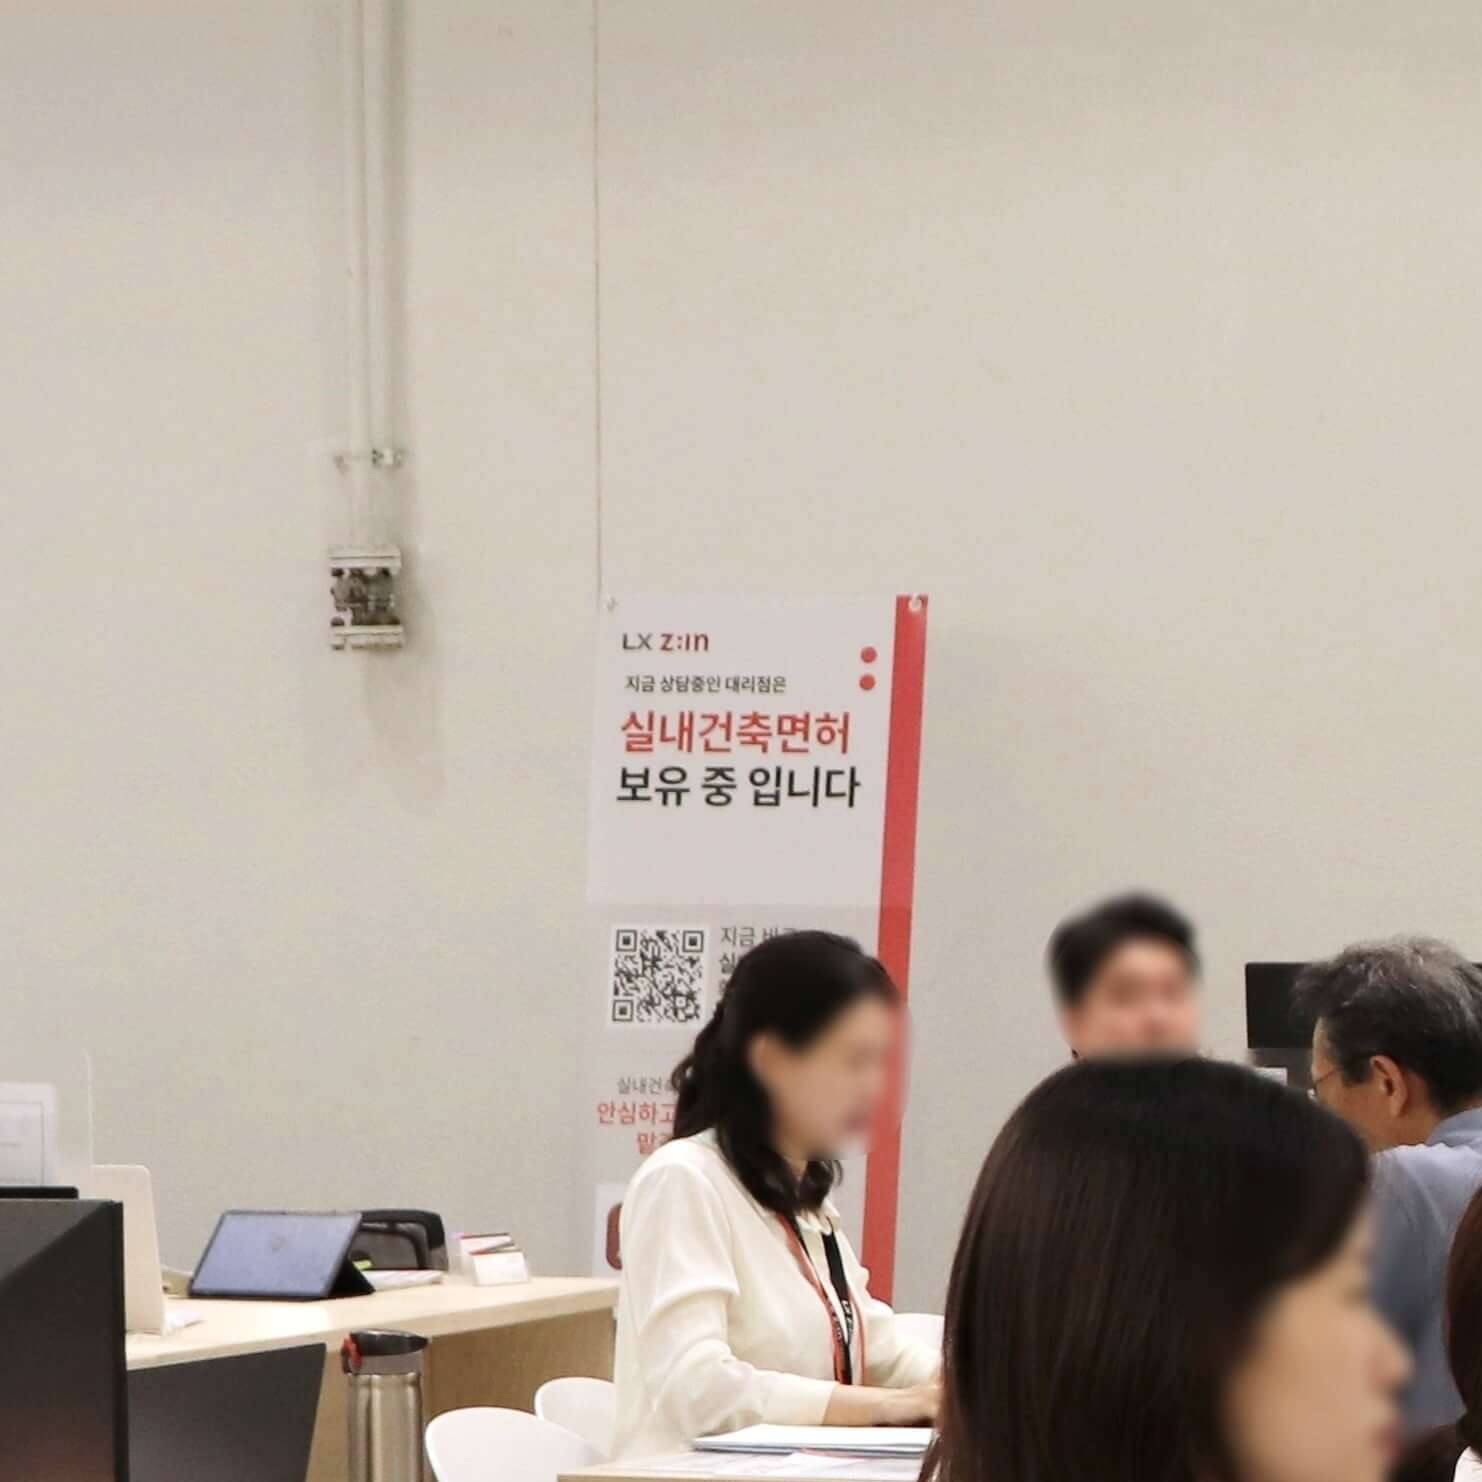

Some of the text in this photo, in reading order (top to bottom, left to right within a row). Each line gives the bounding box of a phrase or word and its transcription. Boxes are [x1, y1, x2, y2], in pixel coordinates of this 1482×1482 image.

[622, 633, 653, 651] LX
[625, 675, 787, 694] 지금 상담중인 대리점은
[621, 711, 851, 755] 실내건축면허
[616, 765, 861, 808] 보유 중 입니다
[720, 926, 755, 947] 지금
